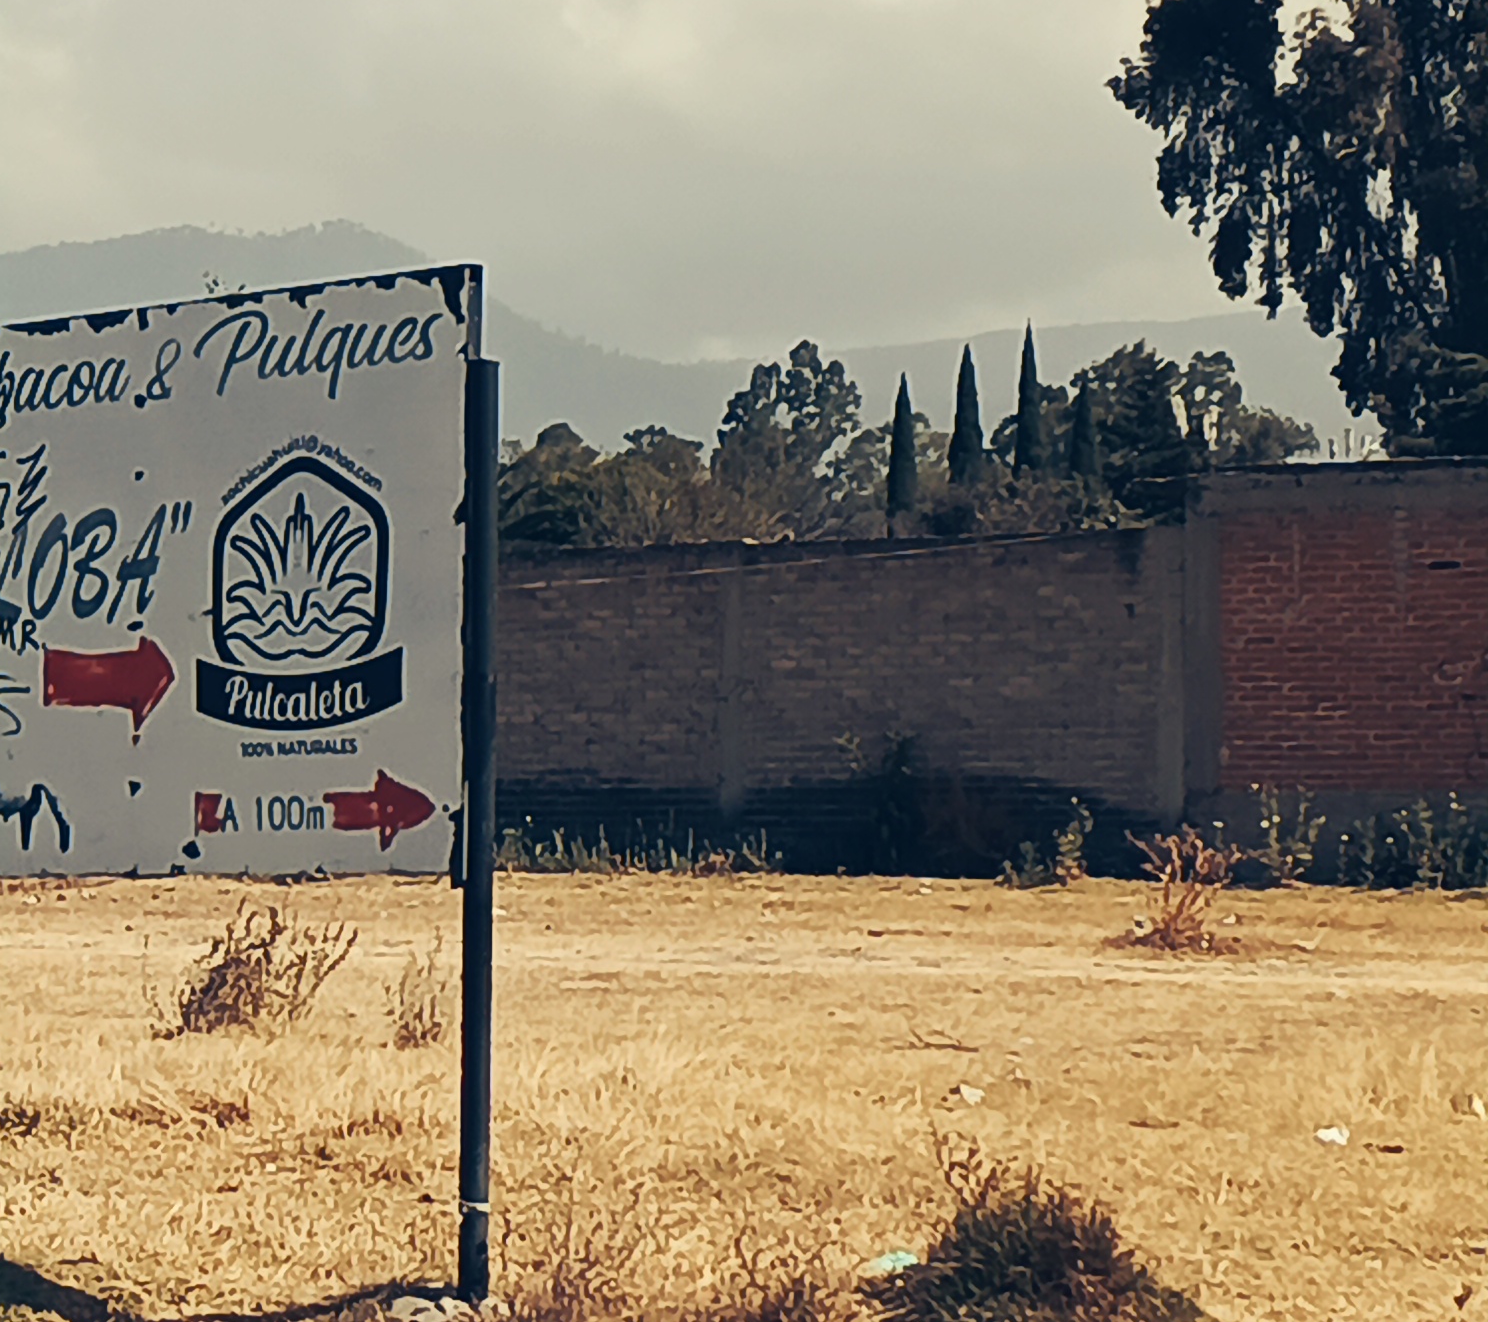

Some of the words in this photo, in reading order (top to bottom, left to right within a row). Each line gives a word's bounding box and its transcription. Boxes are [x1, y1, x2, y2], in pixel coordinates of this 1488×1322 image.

[144, 337, 182, 402] &
[193, 309, 444, 400] Pulques
[225, 675, 371, 722] Pulcaleta
[240, 741, 275, 758] 100%
[277, 737, 358, 757] NATURALES
[220, 797, 239, 833] A
[255, 795, 325, 832] 100m
